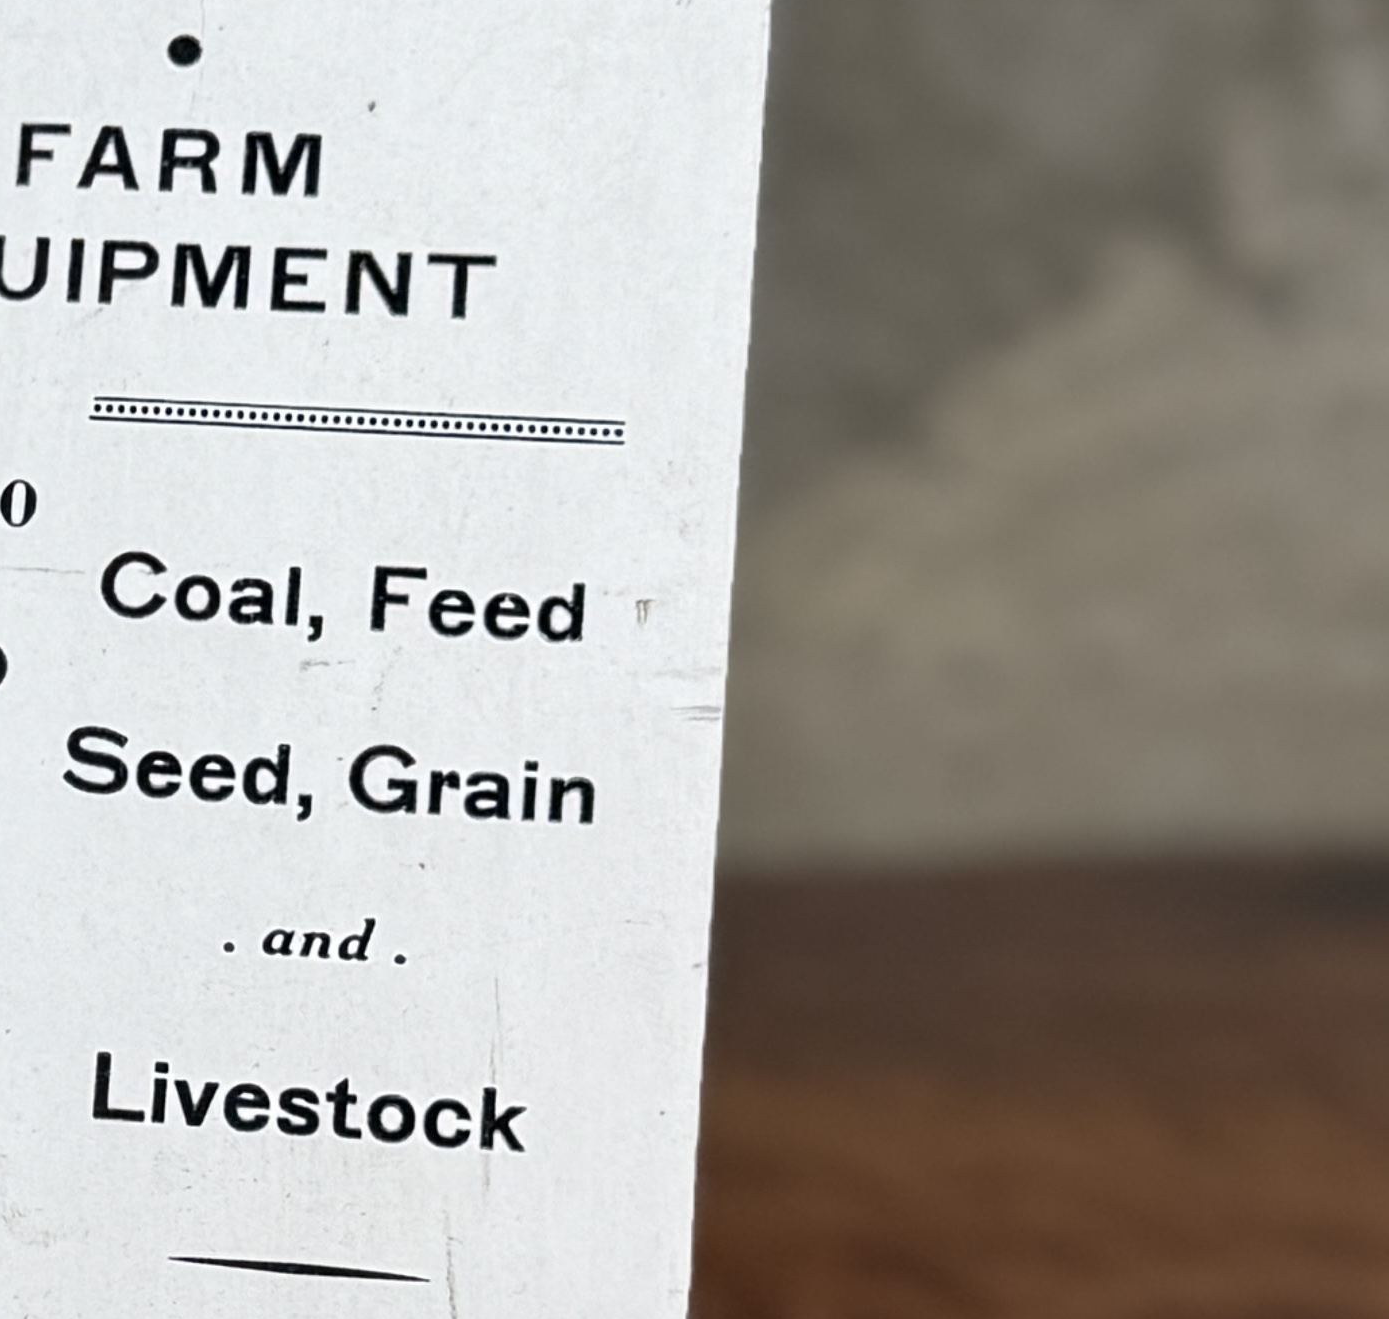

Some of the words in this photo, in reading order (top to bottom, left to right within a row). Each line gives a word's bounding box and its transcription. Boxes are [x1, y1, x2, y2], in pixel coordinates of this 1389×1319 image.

[15, 122, 323, 198] FARM
[99, 550, 325, 643] Coal,
[369, 564, 587, 644] Feed
[61, 725, 314, 823] Seed,
[347, 743, 596, 825] Grain
[91, 1050, 527, 1154] Livestock
